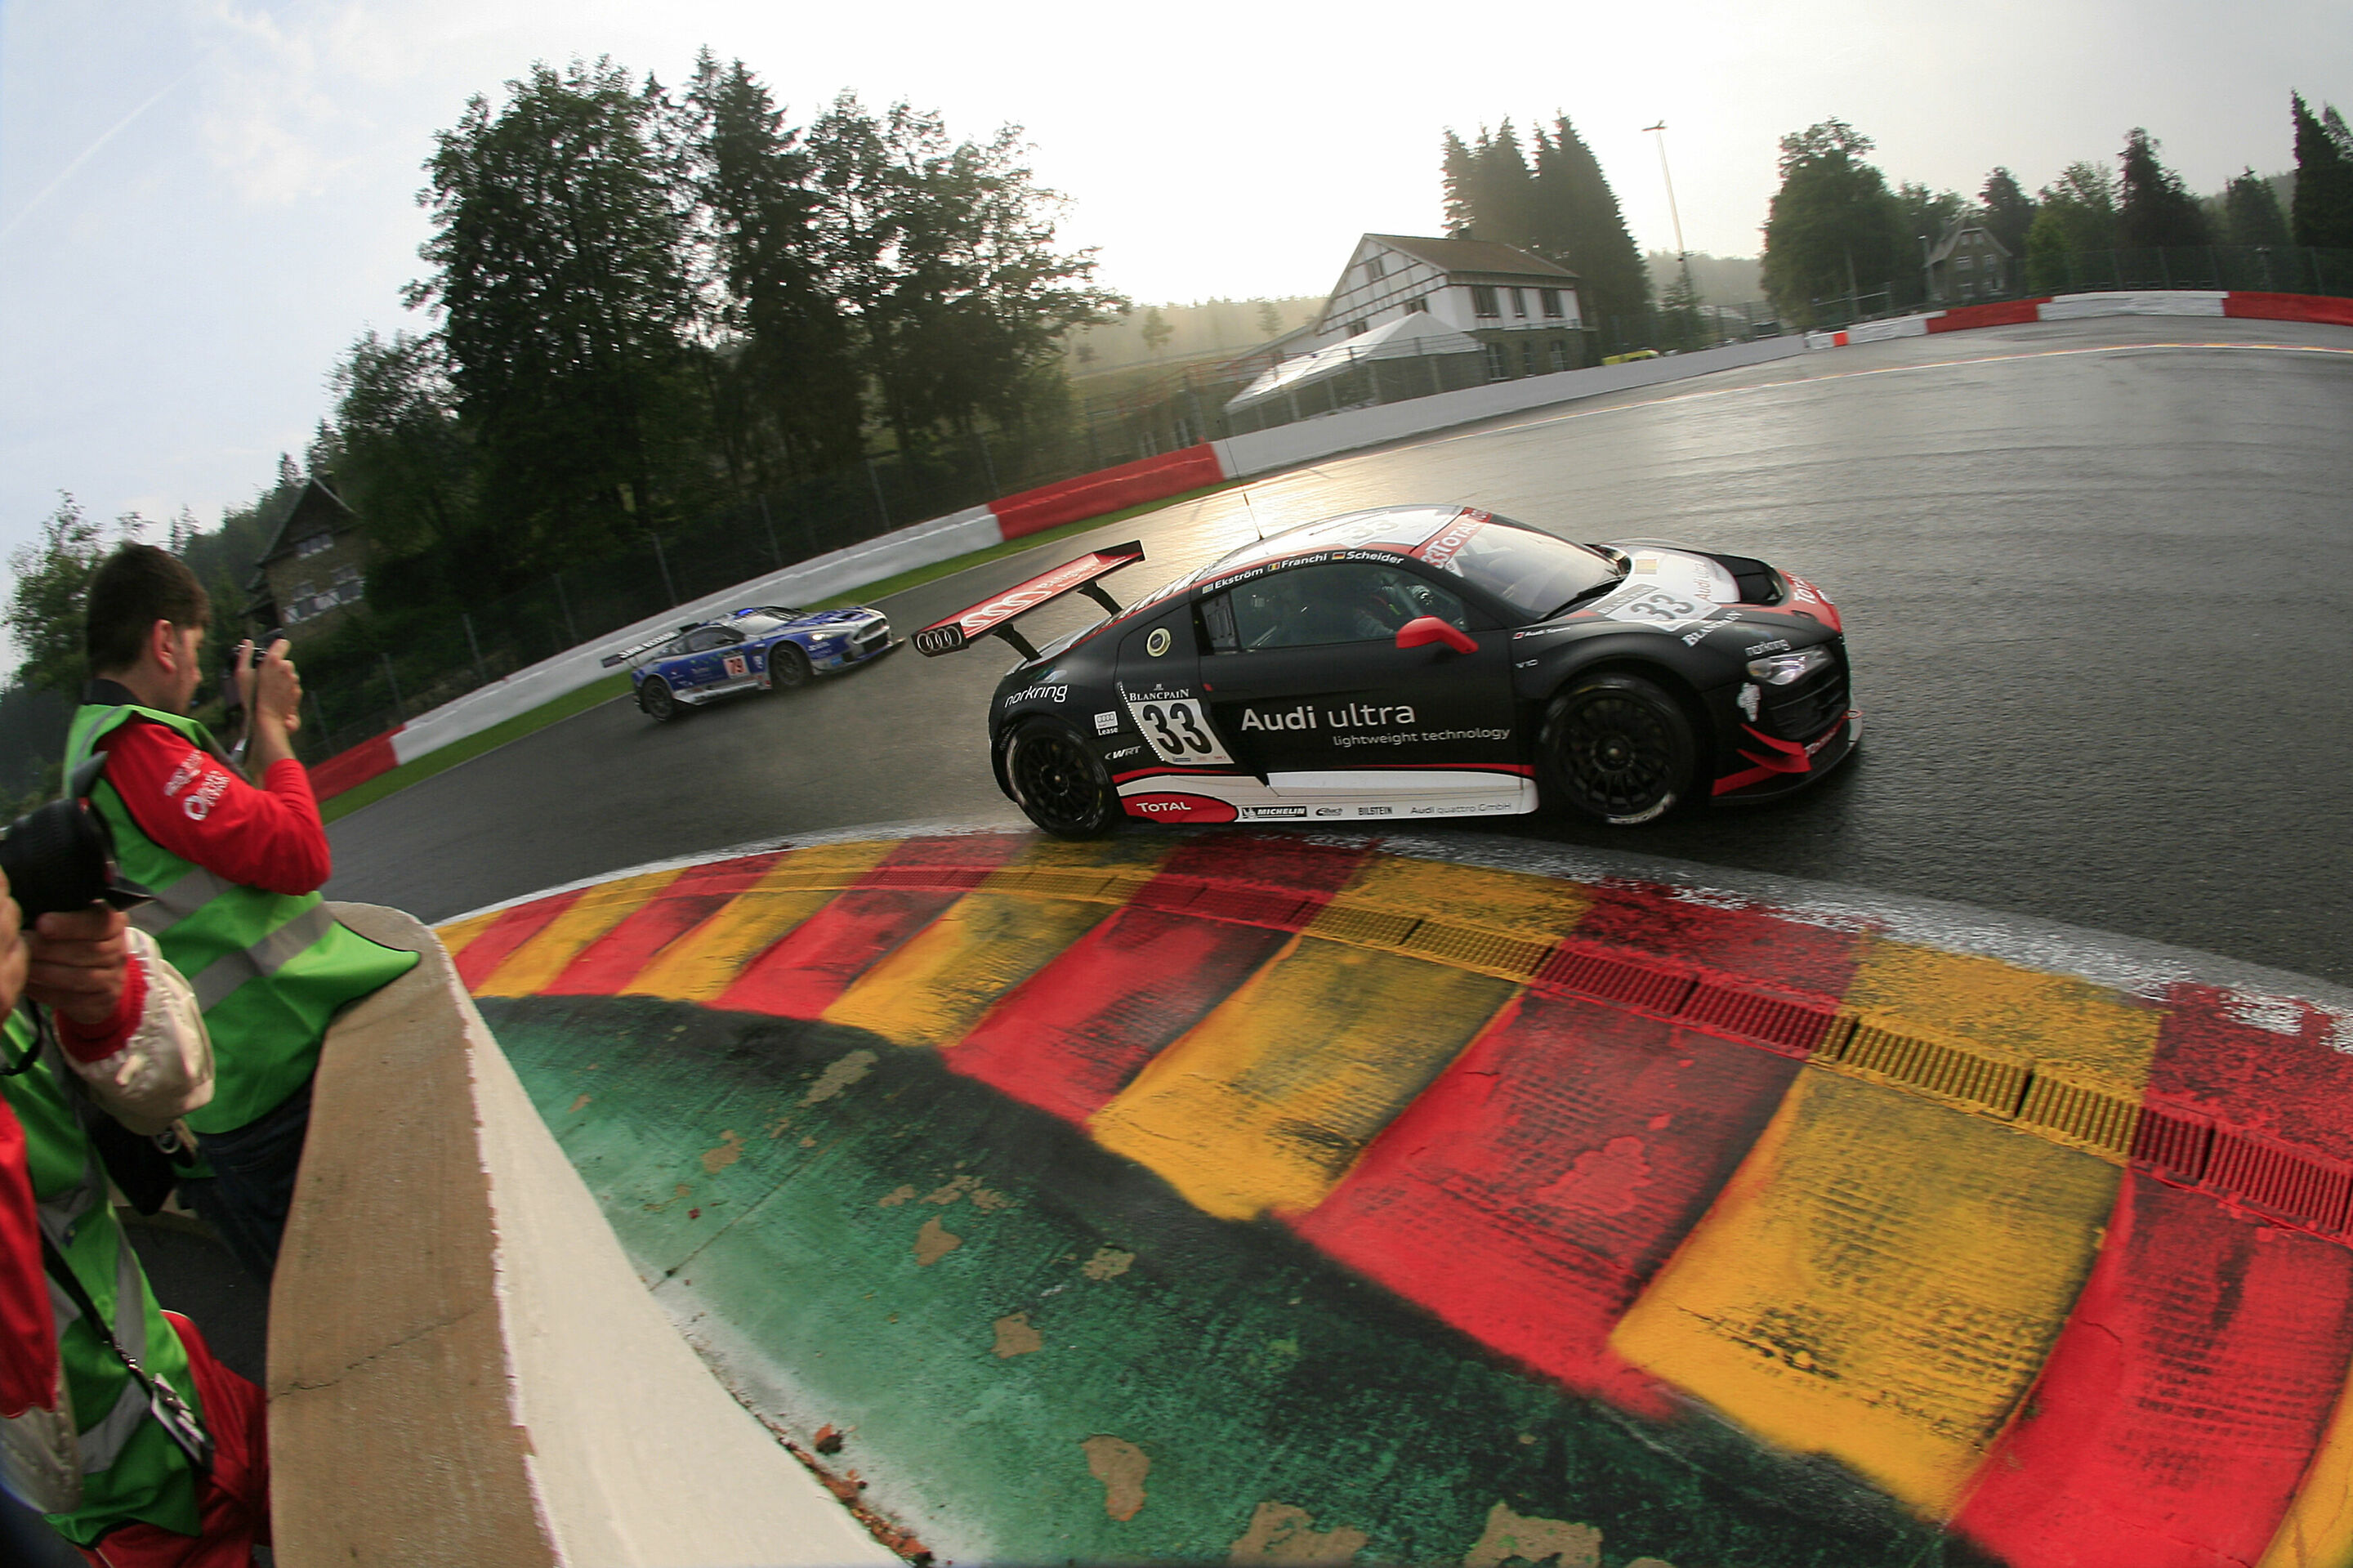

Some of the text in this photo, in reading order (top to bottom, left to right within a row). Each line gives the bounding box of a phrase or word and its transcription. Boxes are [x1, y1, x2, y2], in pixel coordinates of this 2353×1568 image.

[1420, 518, 1480, 570] 33 TOTAL
[1214, 551, 1405, 589] Ekström Franchi Scheider
[1631, 594, 1695, 620] 33
[1004, 684, 1068, 708] norkring
[1129, 689, 1190, 701] BLANCPAIN
[1241, 702, 1416, 730] Audi ultra
[1098, 727, 1118, 736] Lease
[1142, 703, 1213, 755] 33
[1333, 726, 1511, 748] lightweight technology
[1112, 745, 1141, 760] WRT
[1136, 802, 1192, 813] TOTAL
[1257, 806, 1306, 815] MICHELIN
[1358, 806, 1393, 815] BILSTEIN
[1437, 805, 1476, 815] quattro
